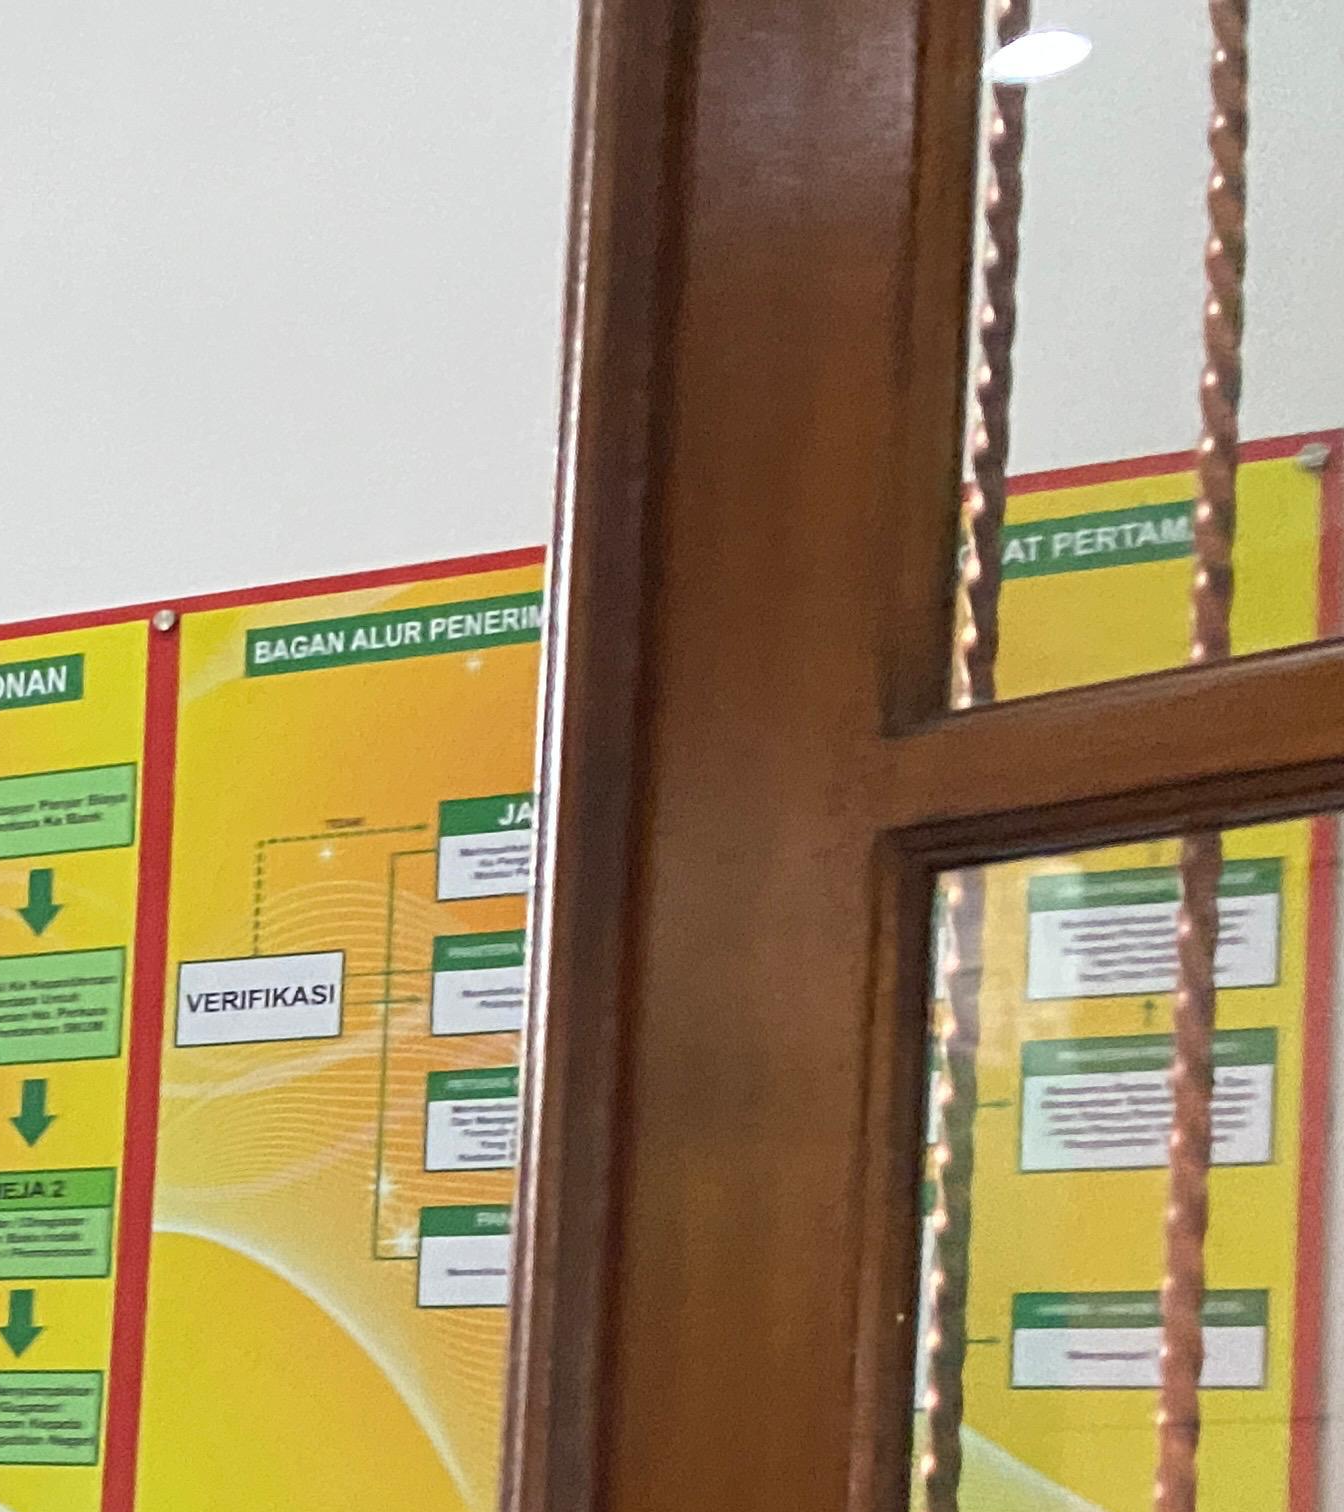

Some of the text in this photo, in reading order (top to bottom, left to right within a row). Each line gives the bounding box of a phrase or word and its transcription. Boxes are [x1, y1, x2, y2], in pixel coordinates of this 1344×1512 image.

[1052, 515, 1194, 559] PERTAM
[253, 630, 345, 664] BAGAN
[351, 621, 421, 651] ALUR
[186, 983, 335, 1014] VERIFIKASI
[50, 1179, 67, 1198] 2
